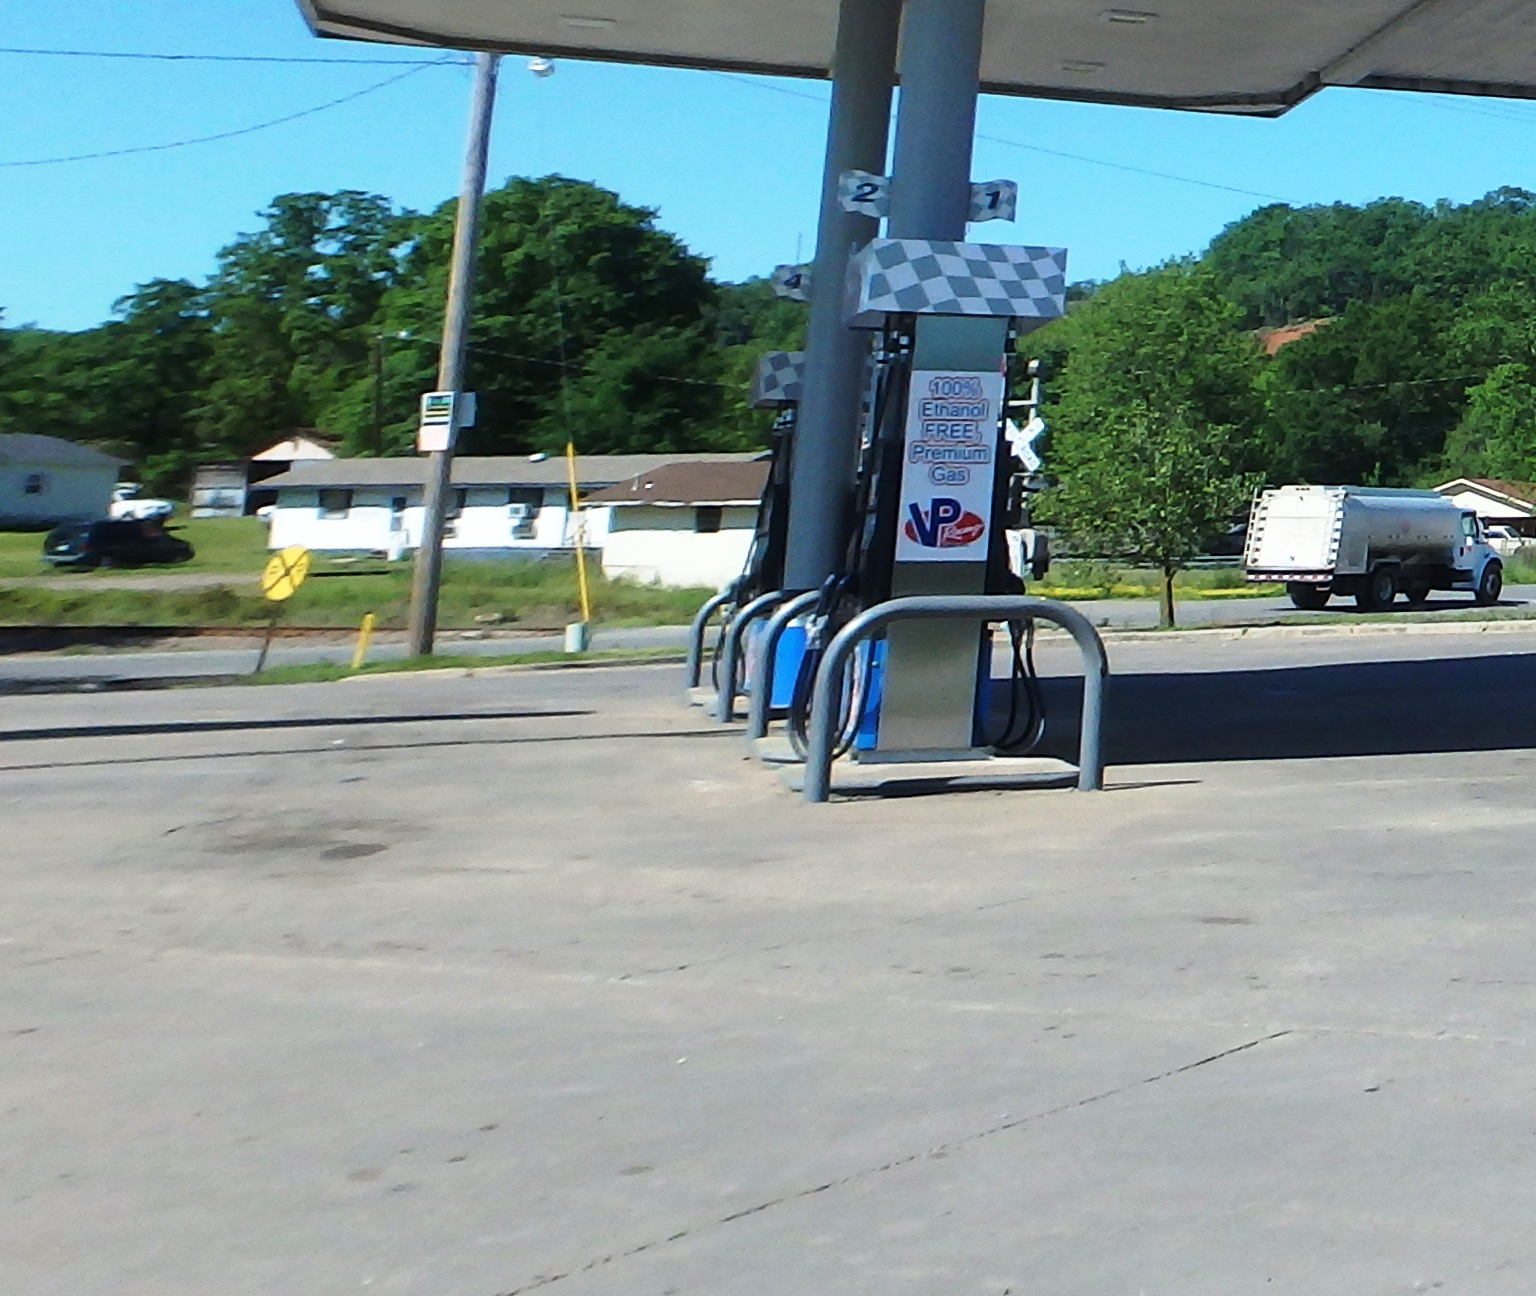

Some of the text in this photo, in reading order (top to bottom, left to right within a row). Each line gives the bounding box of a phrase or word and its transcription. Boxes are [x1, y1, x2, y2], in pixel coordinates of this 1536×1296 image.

[851, 182, 879, 203] 2
[985, 190, 1001, 209] 1
[932, 380, 979, 396] 100%
[921, 401, 985, 417] Ethanol
[912, 444, 987, 460] Premium
[931, 466, 967, 482] Gas
[908, 497, 962, 547] VP
